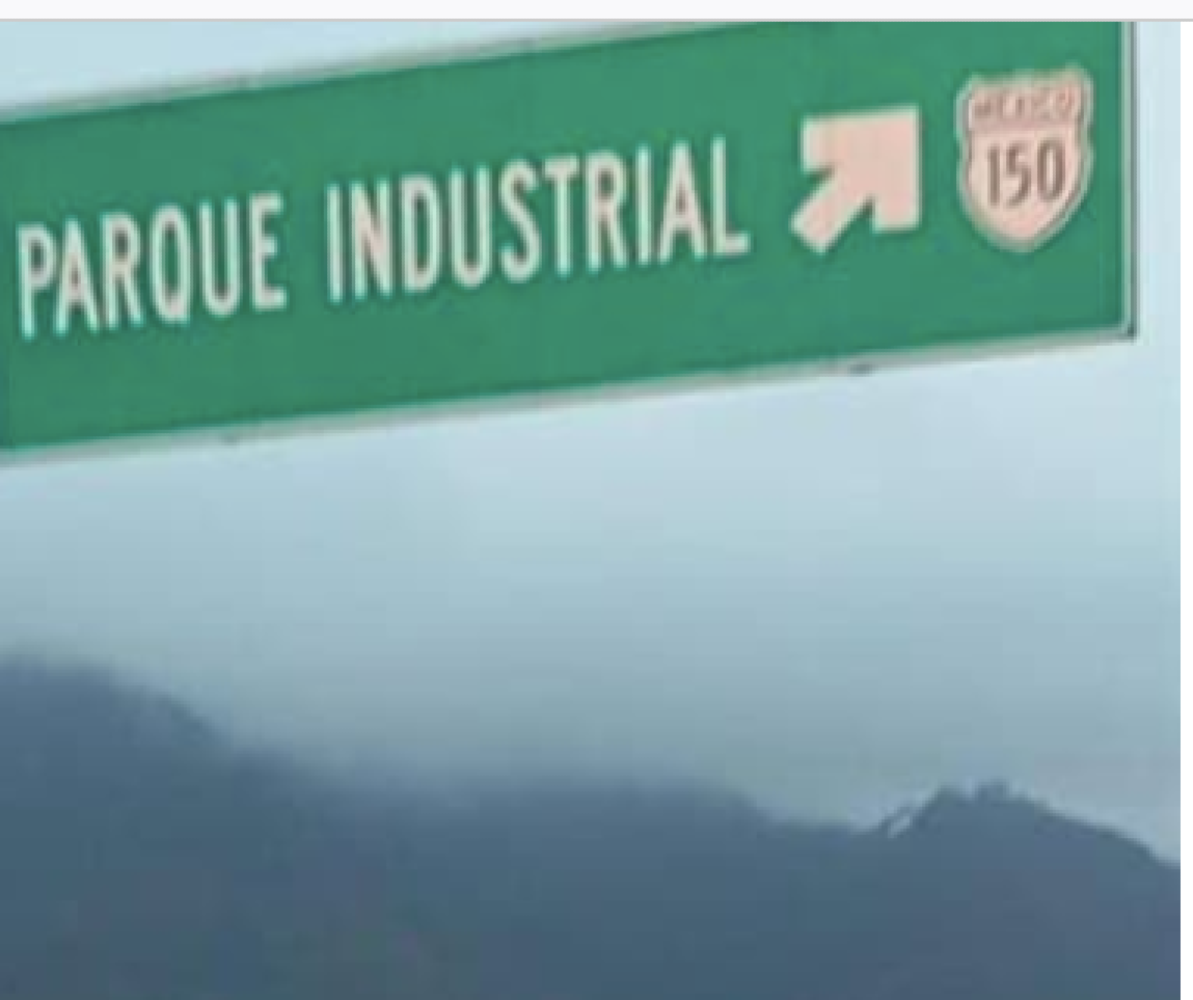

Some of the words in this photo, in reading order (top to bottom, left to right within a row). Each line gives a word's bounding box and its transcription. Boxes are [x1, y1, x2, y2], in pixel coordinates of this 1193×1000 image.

[16, 192, 287, 336] PARQUE
[325, 139, 751, 302] INDUSTRIAL
[987, 138, 1066, 211] 150
